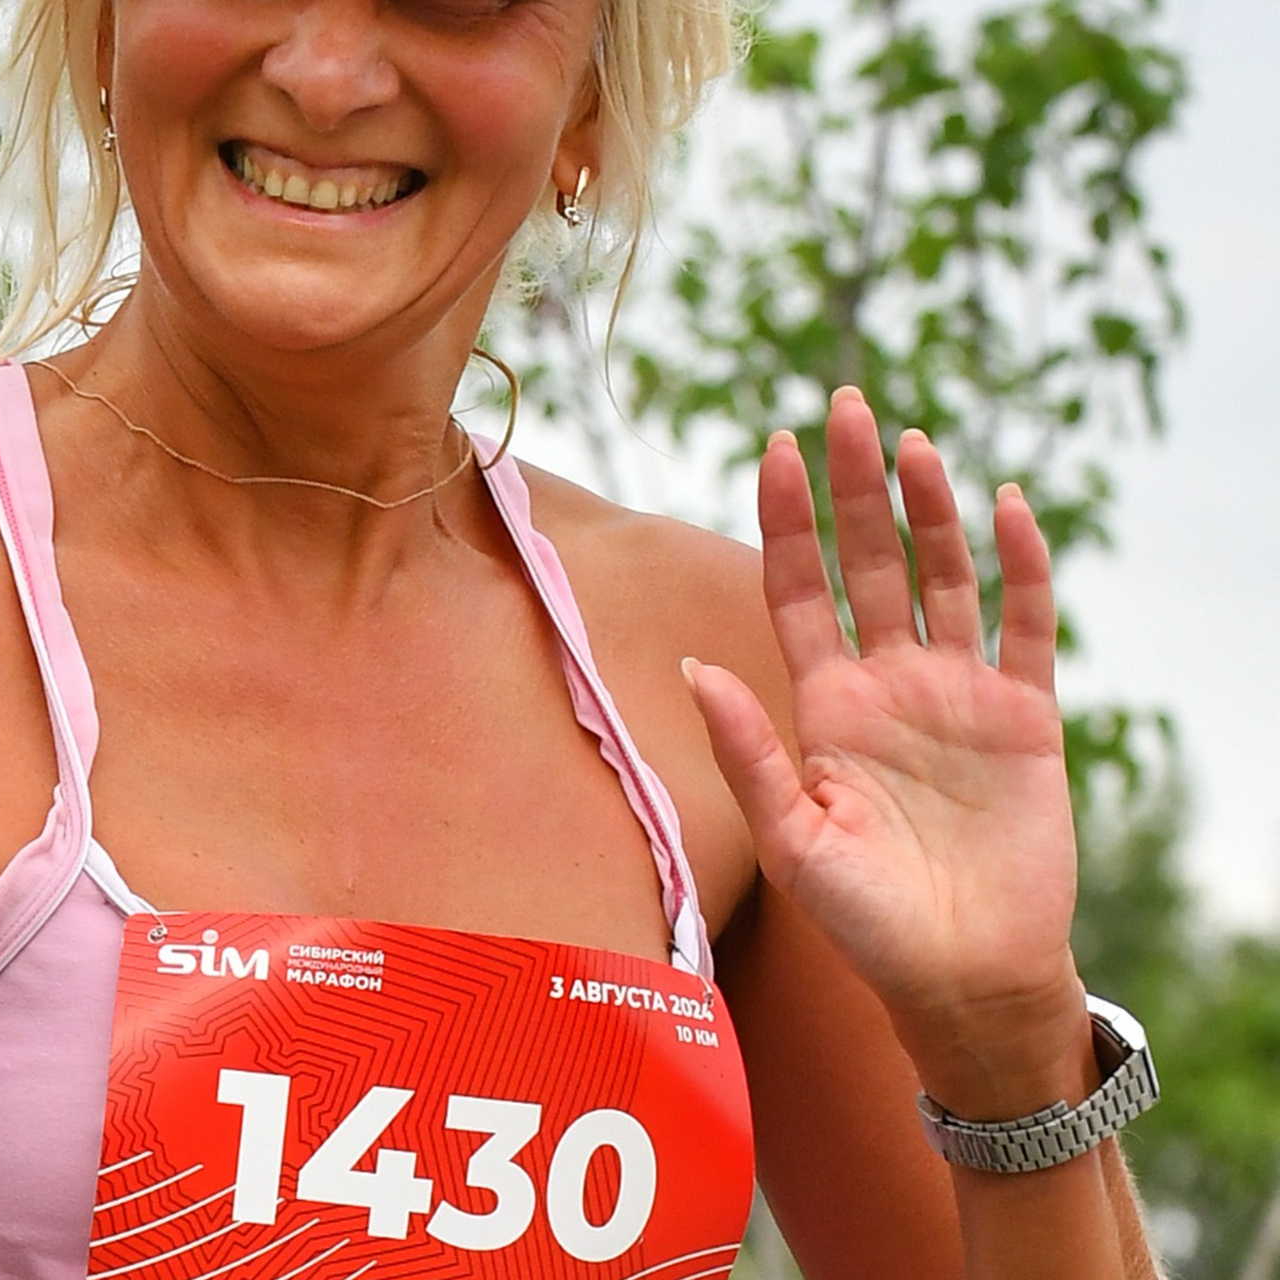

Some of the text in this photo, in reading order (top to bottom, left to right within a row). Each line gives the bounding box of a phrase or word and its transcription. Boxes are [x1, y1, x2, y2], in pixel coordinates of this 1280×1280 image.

[288, 945, 384, 965] СИБИРСКИЙ
[286, 969, 382, 991] МАРАФОН
[549, 976, 564, 998] 3
[570, 979, 668, 1013] АВГУСТА
[676, 1025, 719, 1048] 10 КМ
[217, 1069, 657, 1262] 1430
